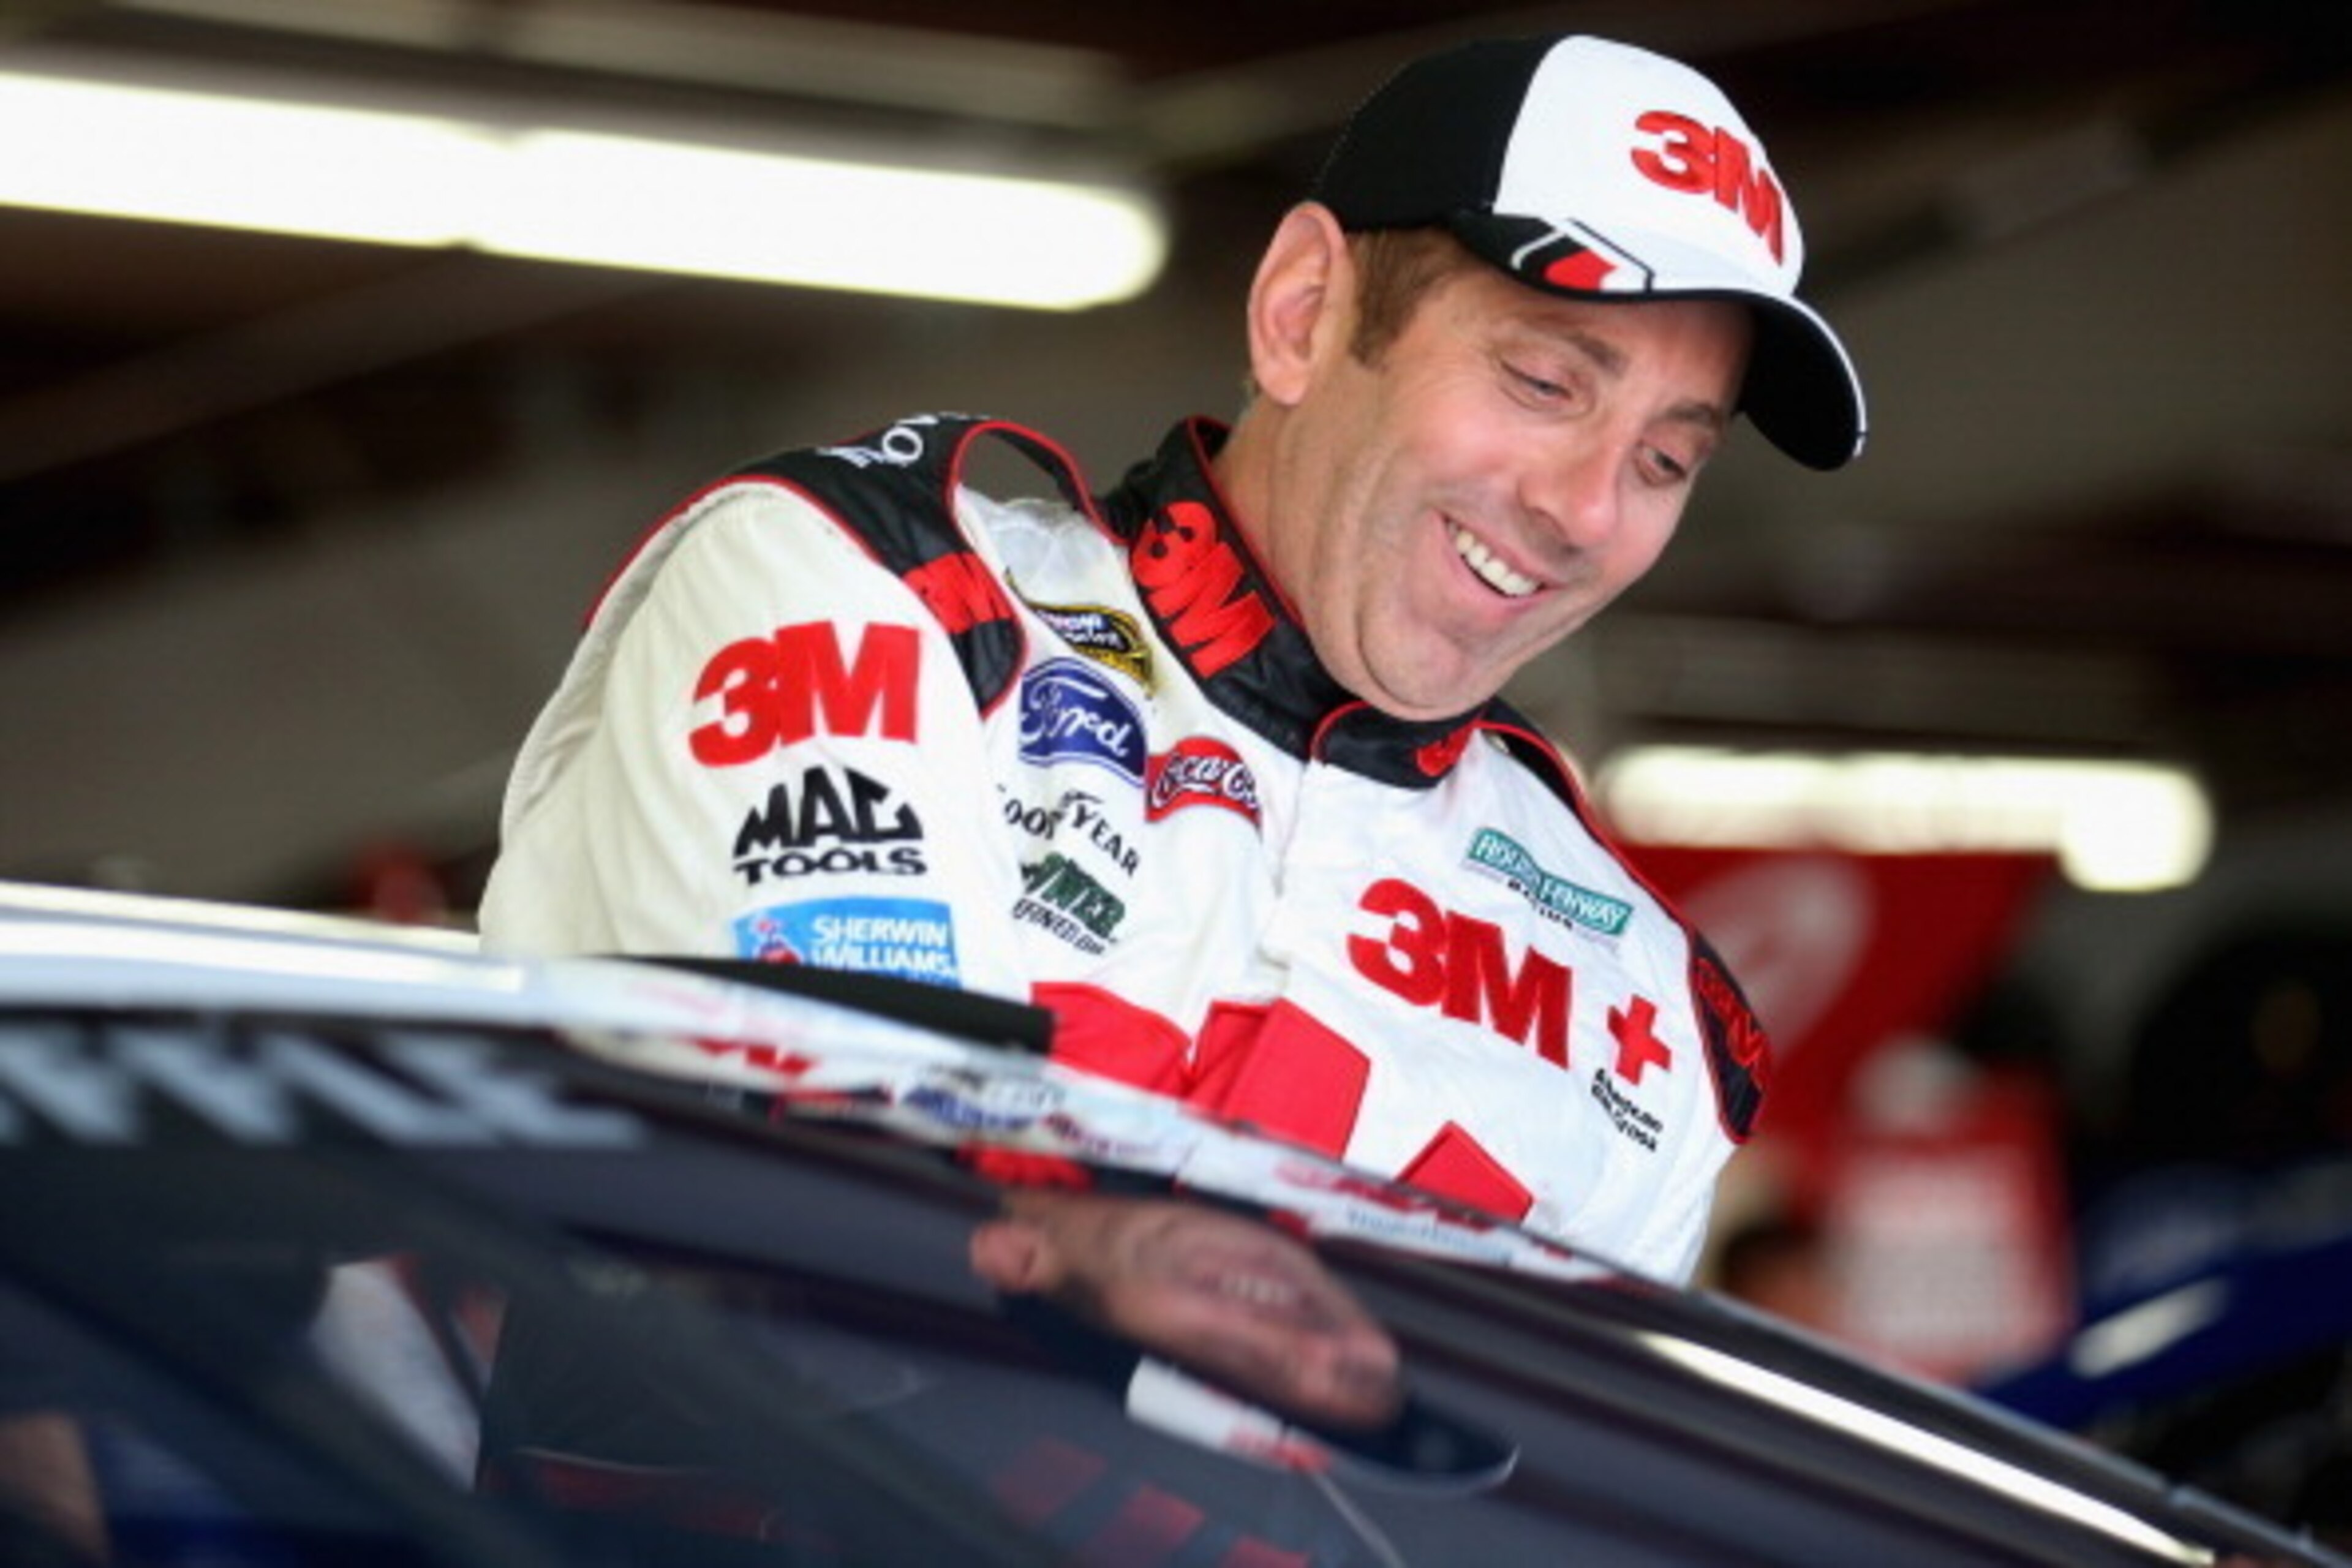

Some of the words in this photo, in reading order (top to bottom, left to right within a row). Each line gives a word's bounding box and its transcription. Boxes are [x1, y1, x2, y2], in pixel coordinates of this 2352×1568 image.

[1630, 110, 1784, 266] 3M
[1133, 502, 1275, 678] 3M
[689, 620, 921, 765] 3M
[1020, 677, 1131, 757] Ford
[733, 766, 923, 859] MAC
[733, 847, 927, 886] TOOLS
[812, 915, 948, 948] SHERWIN
[1347, 878, 1573, 1071] 3M
